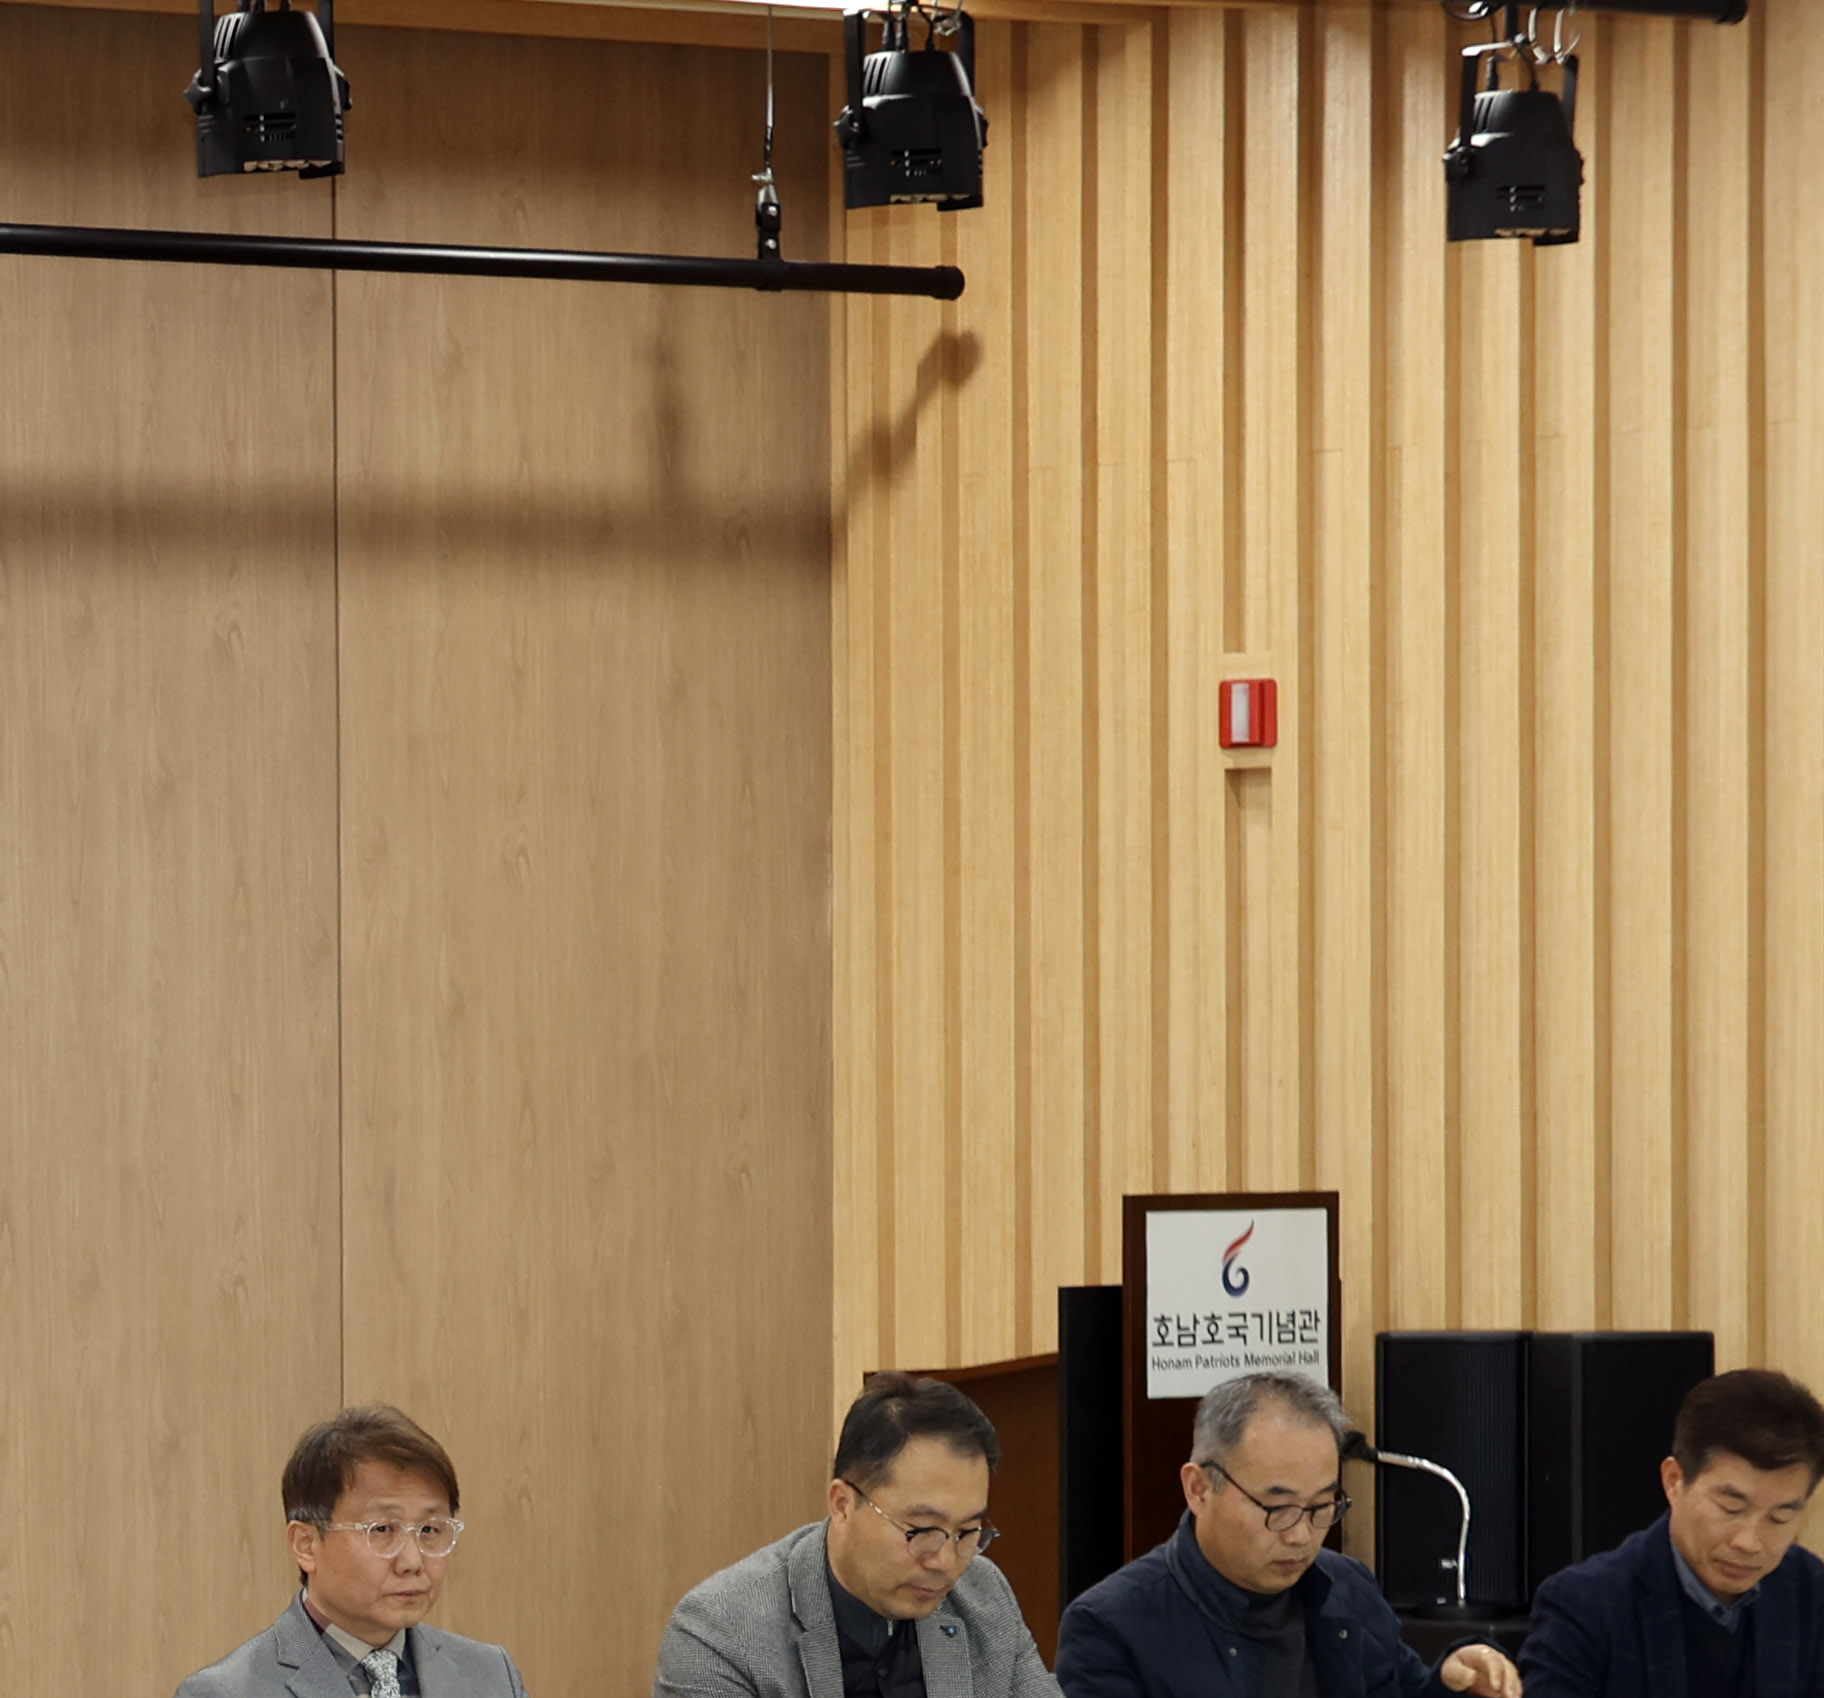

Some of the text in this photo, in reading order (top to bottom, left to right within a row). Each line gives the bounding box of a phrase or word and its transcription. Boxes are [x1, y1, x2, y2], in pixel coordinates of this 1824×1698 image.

[1152, 1310, 1320, 1348] 호남호국기념관
[1152, 1350, 1319, 1371] Honam Patriots Memorial Hall
